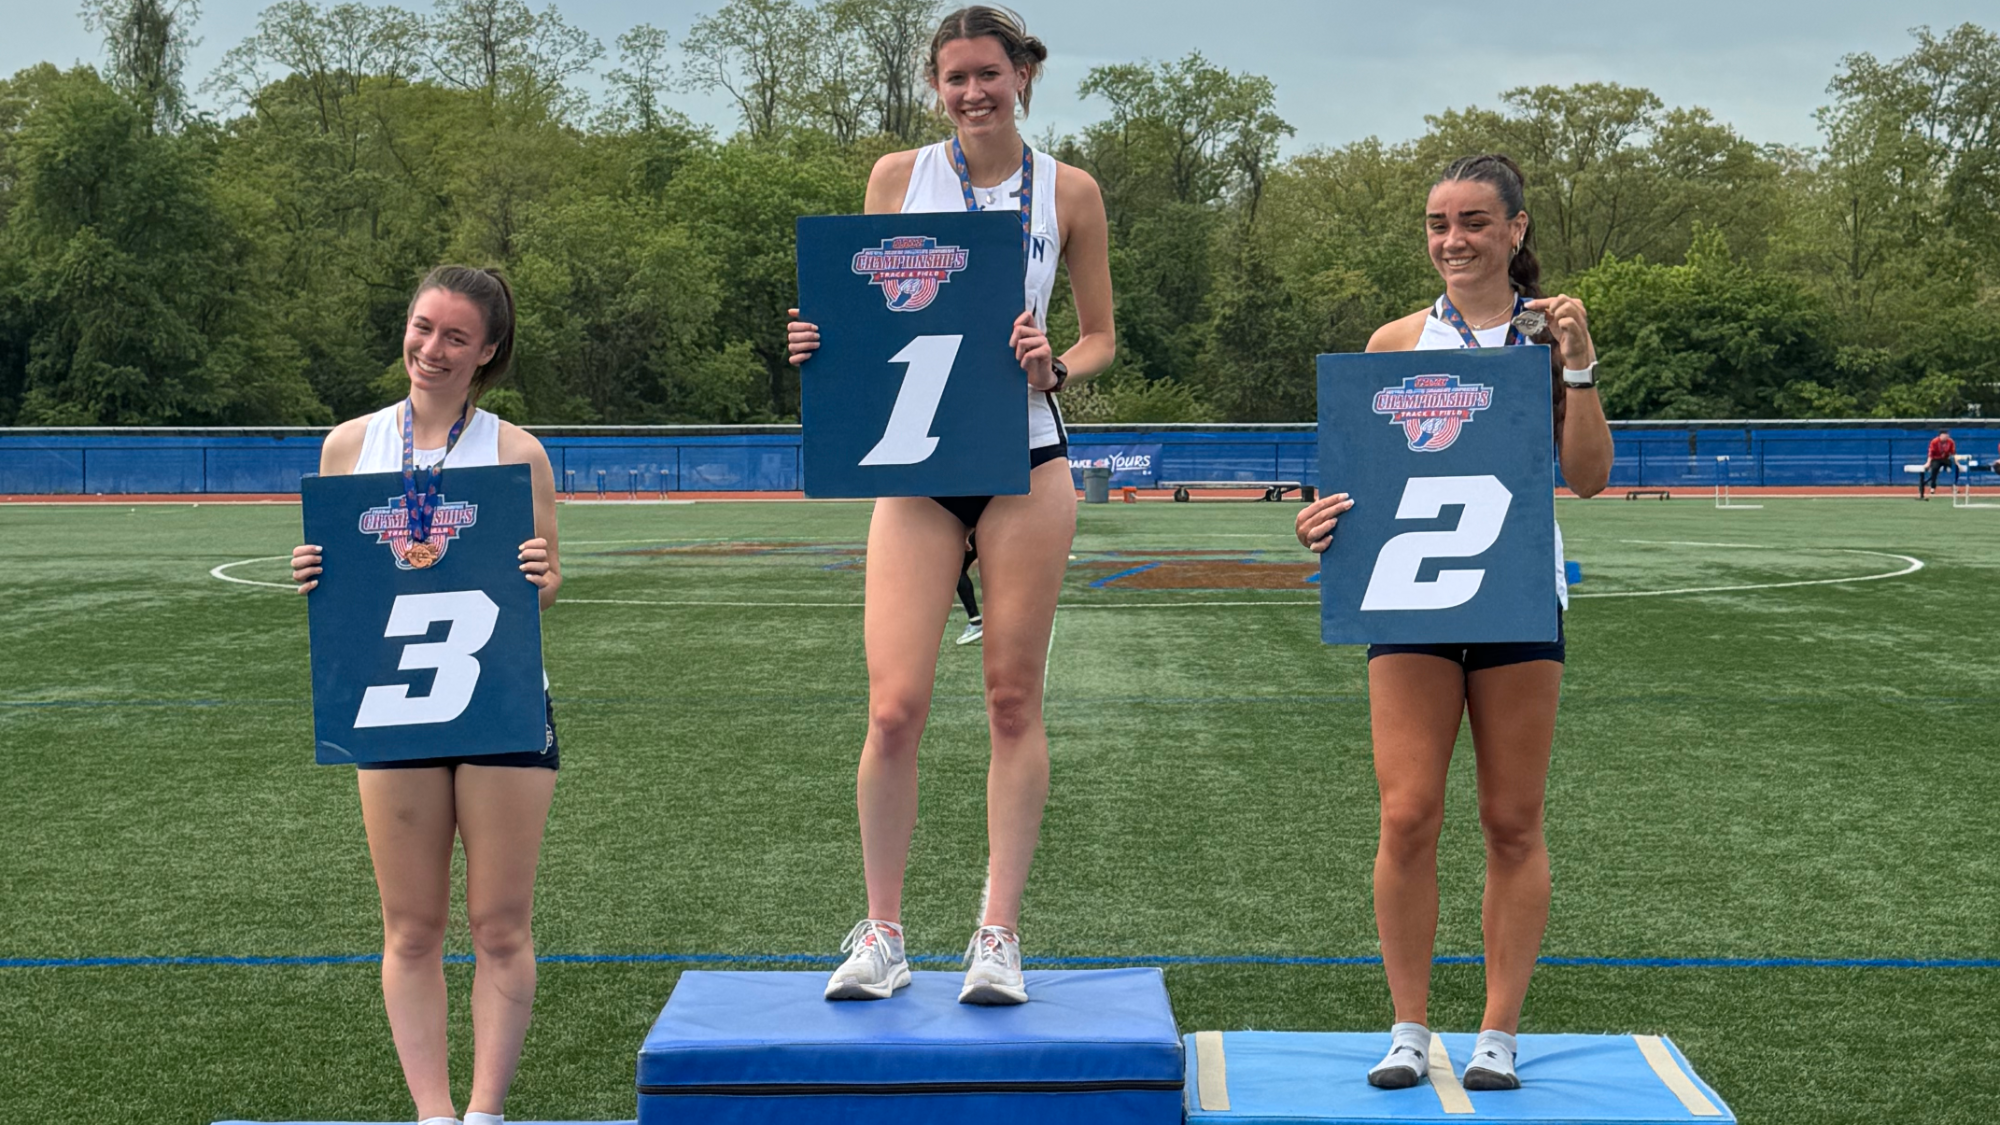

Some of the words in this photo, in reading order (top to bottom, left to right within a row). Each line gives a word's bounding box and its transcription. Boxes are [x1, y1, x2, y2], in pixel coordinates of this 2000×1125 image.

[856, 253, 965, 270] CHAMPIONSHIPS
[858, 334, 963, 466] 1
[1376, 391, 1489, 410] CHAMPIONSHIPS
[1109, 451, 1151, 472] YOURS
[1360, 474, 1513, 611] 2
[353, 589, 500, 729] 3
